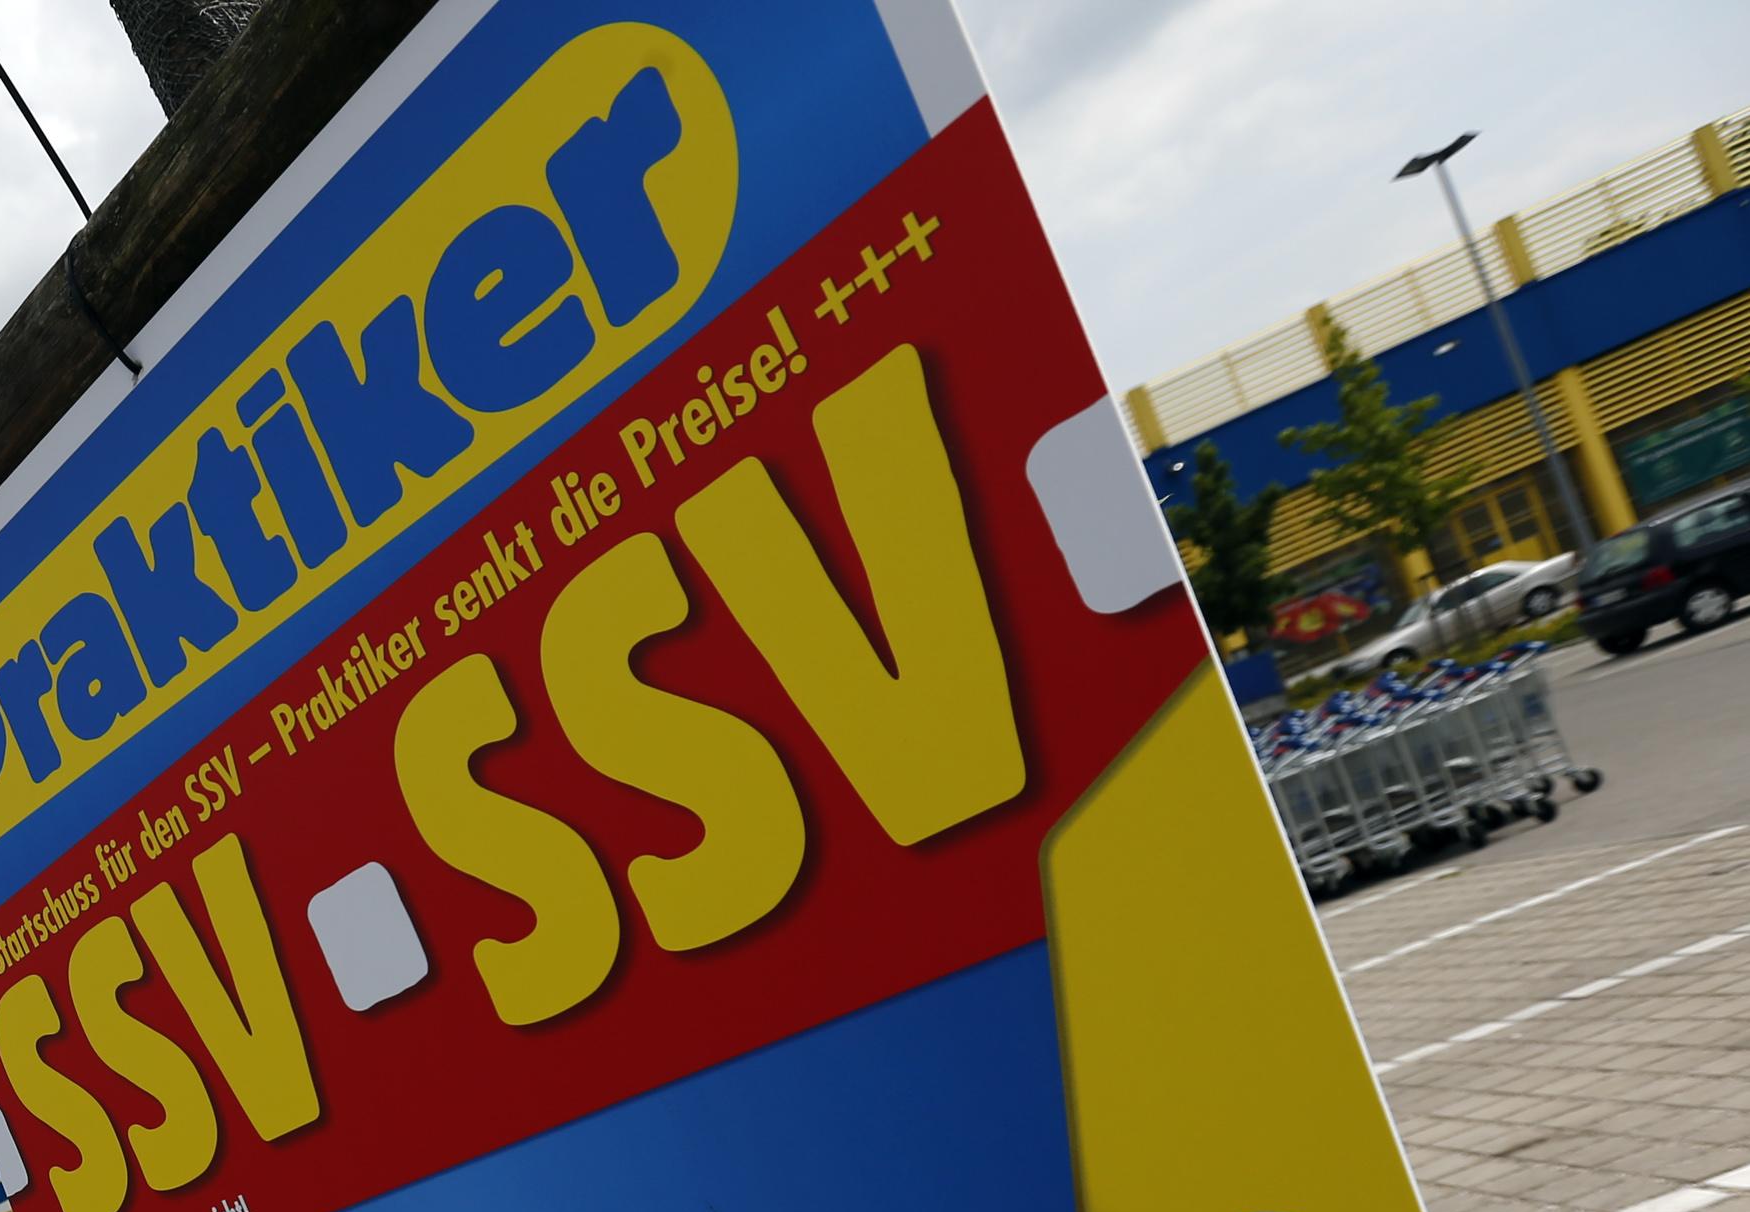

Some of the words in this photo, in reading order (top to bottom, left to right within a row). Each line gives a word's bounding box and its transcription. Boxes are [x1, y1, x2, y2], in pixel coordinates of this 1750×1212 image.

[94, 841, 139, 891] für
[138, 805, 191, 860] den
[185, 744, 243, 823] SSV
[269, 618, 428, 756] Praktiker
[434, 521, 545, 637] senkt
[550, 471, 622, 547] die
[618, 304, 809, 488] Preise!
[814, 211, 941, 325] +++
[393, 343, 1027, 1026] SSV
